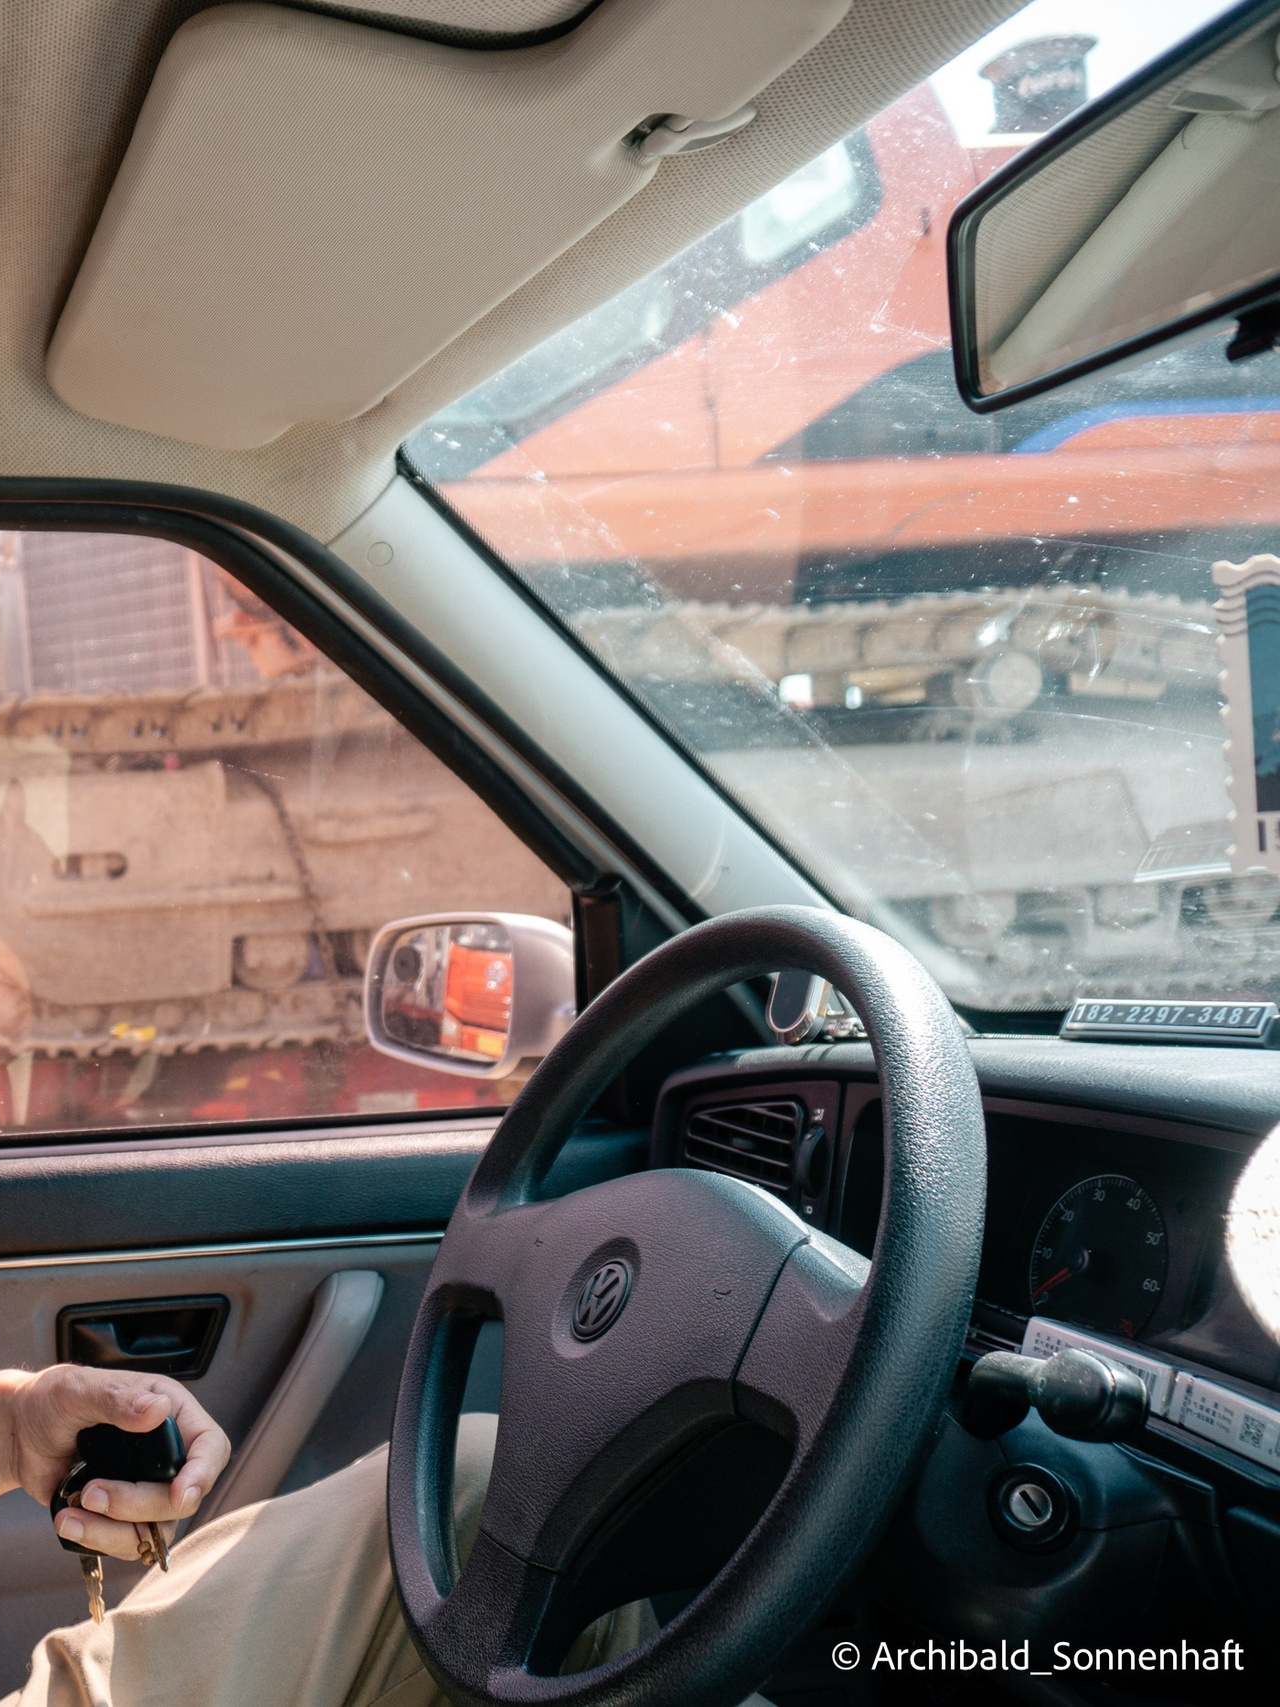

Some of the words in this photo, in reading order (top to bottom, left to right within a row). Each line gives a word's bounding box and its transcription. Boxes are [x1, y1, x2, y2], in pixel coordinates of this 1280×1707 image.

[1075, 1003, 1261, 1026] 182-2297-3487
[1093, 1188, 1106, 1202] 30
[1126, 1197, 1142, 1211] 40
[1060, 1209, 1074, 1222] 20
[1145, 1232, 1161, 1246] 50
[1043, 1247, 1053, 1259] 10
[1142, 1278, 1157, 1292] 60
